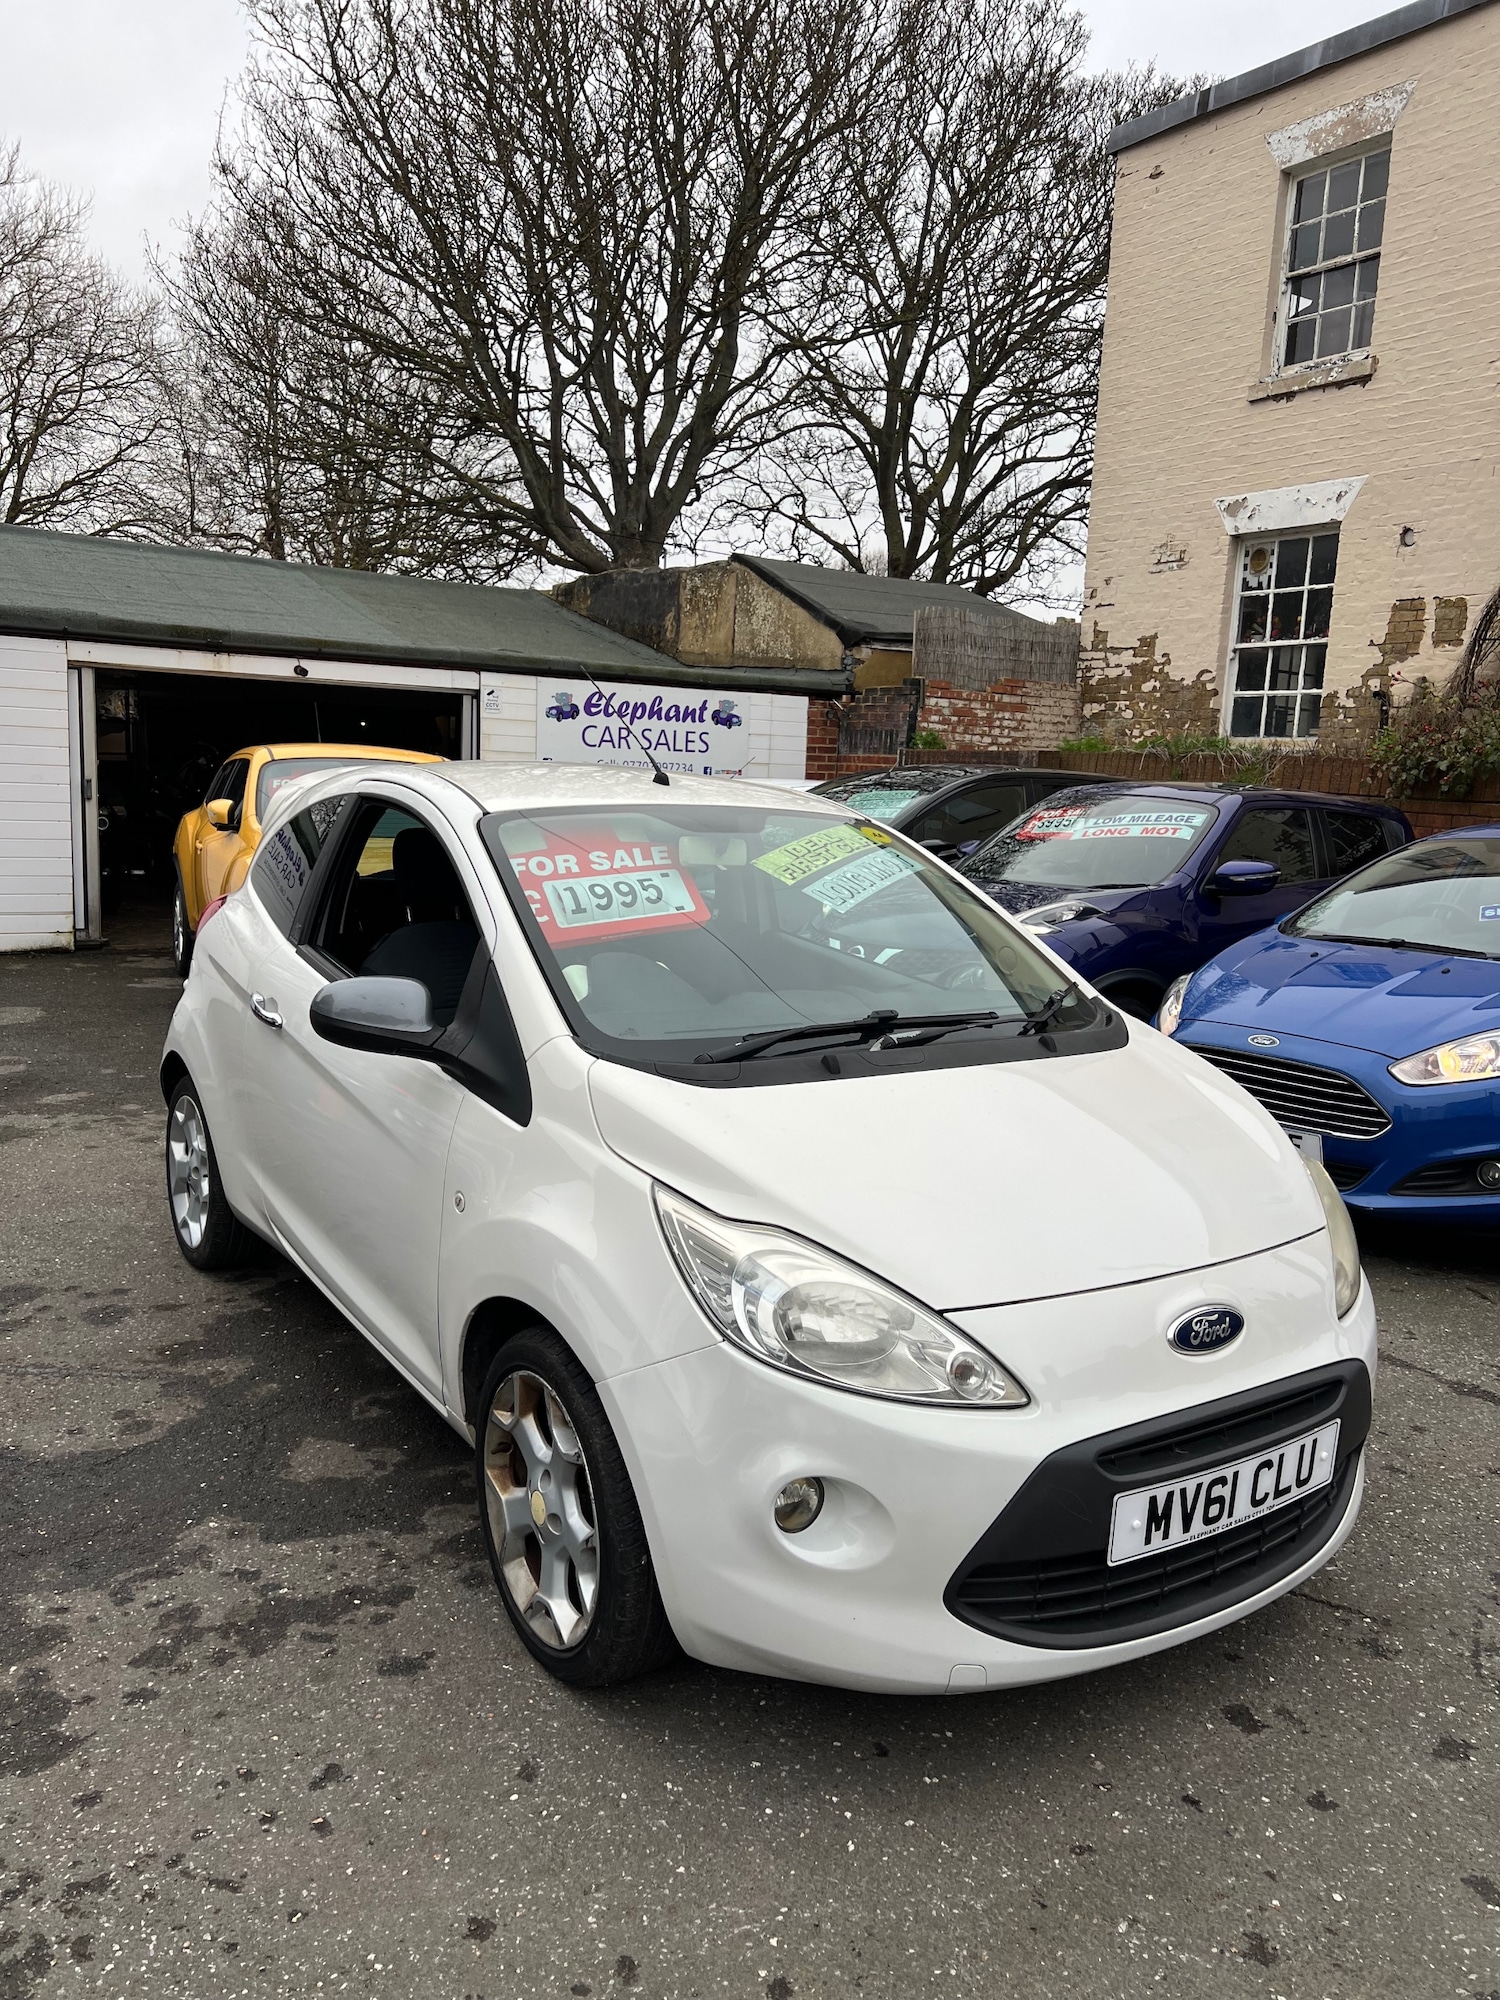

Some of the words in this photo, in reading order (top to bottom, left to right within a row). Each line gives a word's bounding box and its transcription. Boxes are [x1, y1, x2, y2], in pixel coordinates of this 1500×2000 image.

[583, 691, 708, 726] Elephant
[581, 725, 631, 750] CAR
[641, 728, 709, 753] SALES
[1081, 828, 1130, 838] LONG
[1140, 826, 1183, 836] MOT
[1093, 816, 1124, 826] LOW
[1128, 814, 1196, 824] MILEAGE
[779, 832, 840, 860] IDEAL
[509, 854, 580, 879] FOR
[588, 846, 672, 871] SALE
[563, 877, 664, 915] 1995
[1190, 1313, 1231, 1346] Ford
[1144, 1470, 1240, 1546] MV61
[1250, 1437, 1318, 1508] CLU
[1190, 1526, 1220, 1541] ELEPHANT
[1221, 1521, 1233, 1530] CAR
[1234, 1514, 1251, 1524] SALES
